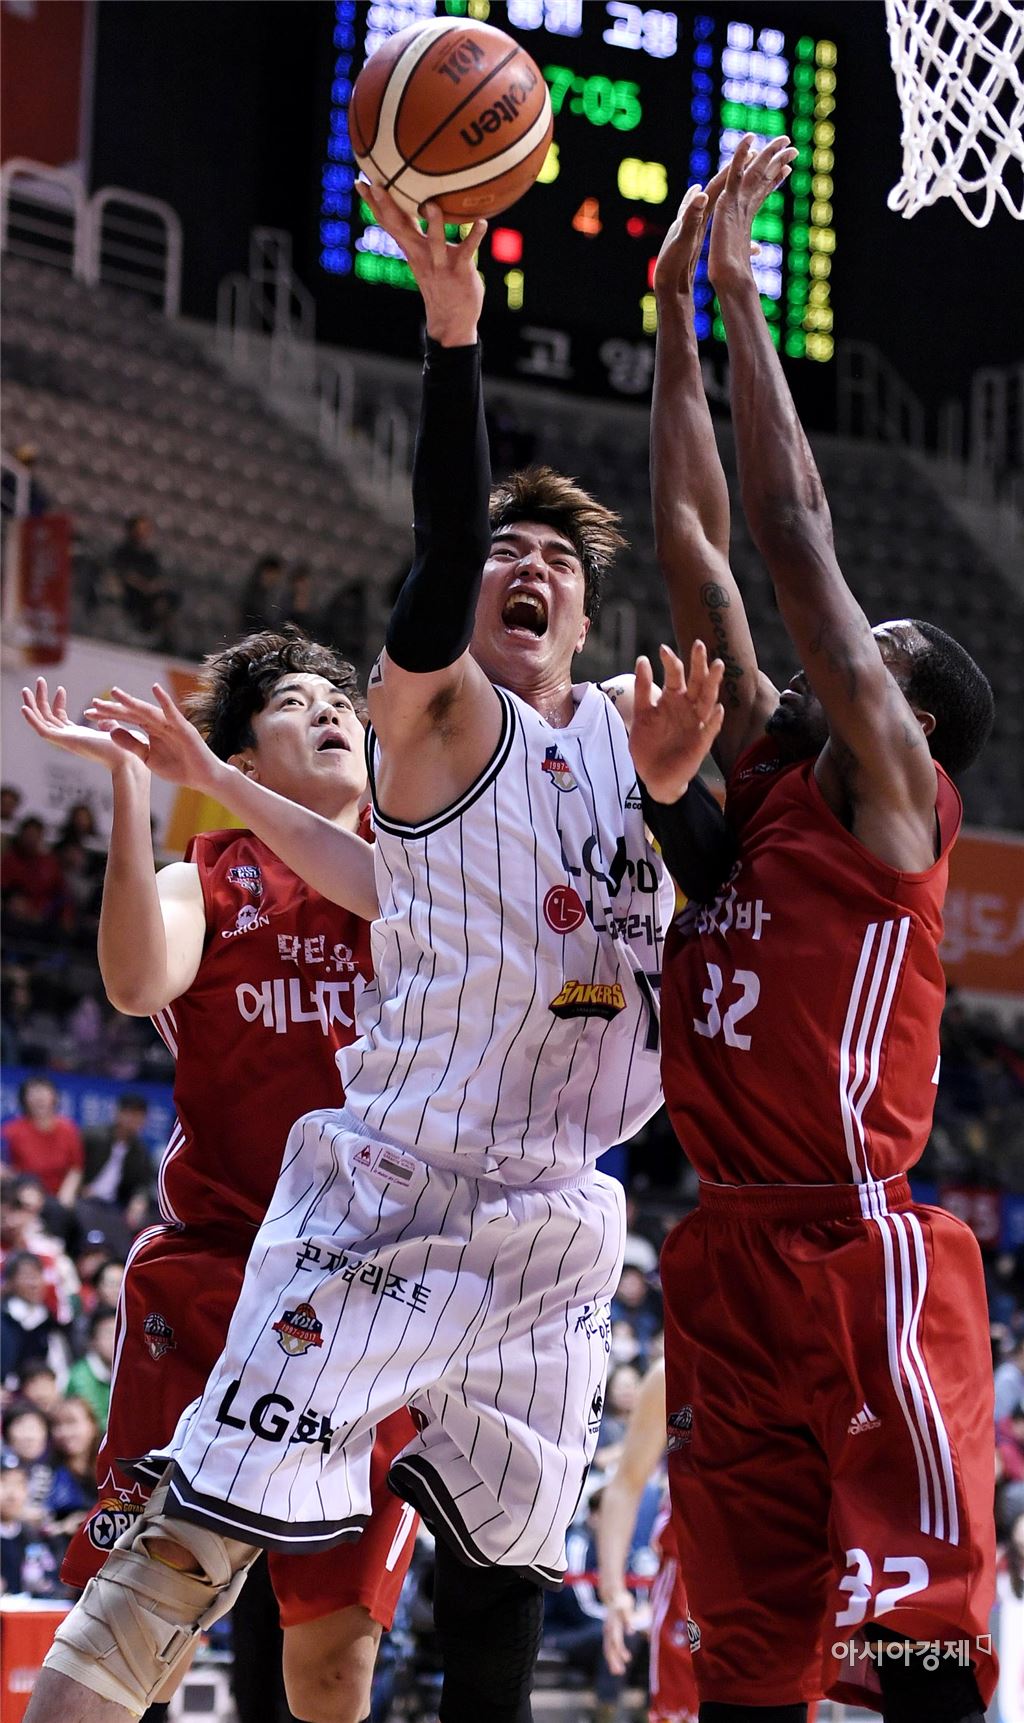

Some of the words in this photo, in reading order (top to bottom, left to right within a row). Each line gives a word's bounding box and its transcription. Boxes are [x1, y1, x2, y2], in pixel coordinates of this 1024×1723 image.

[460, 64, 538, 147] molten
[551, 980, 626, 1010] SAKERS
[693, 962, 761, 1051] 32
[834, 1548, 930, 1627] 32
